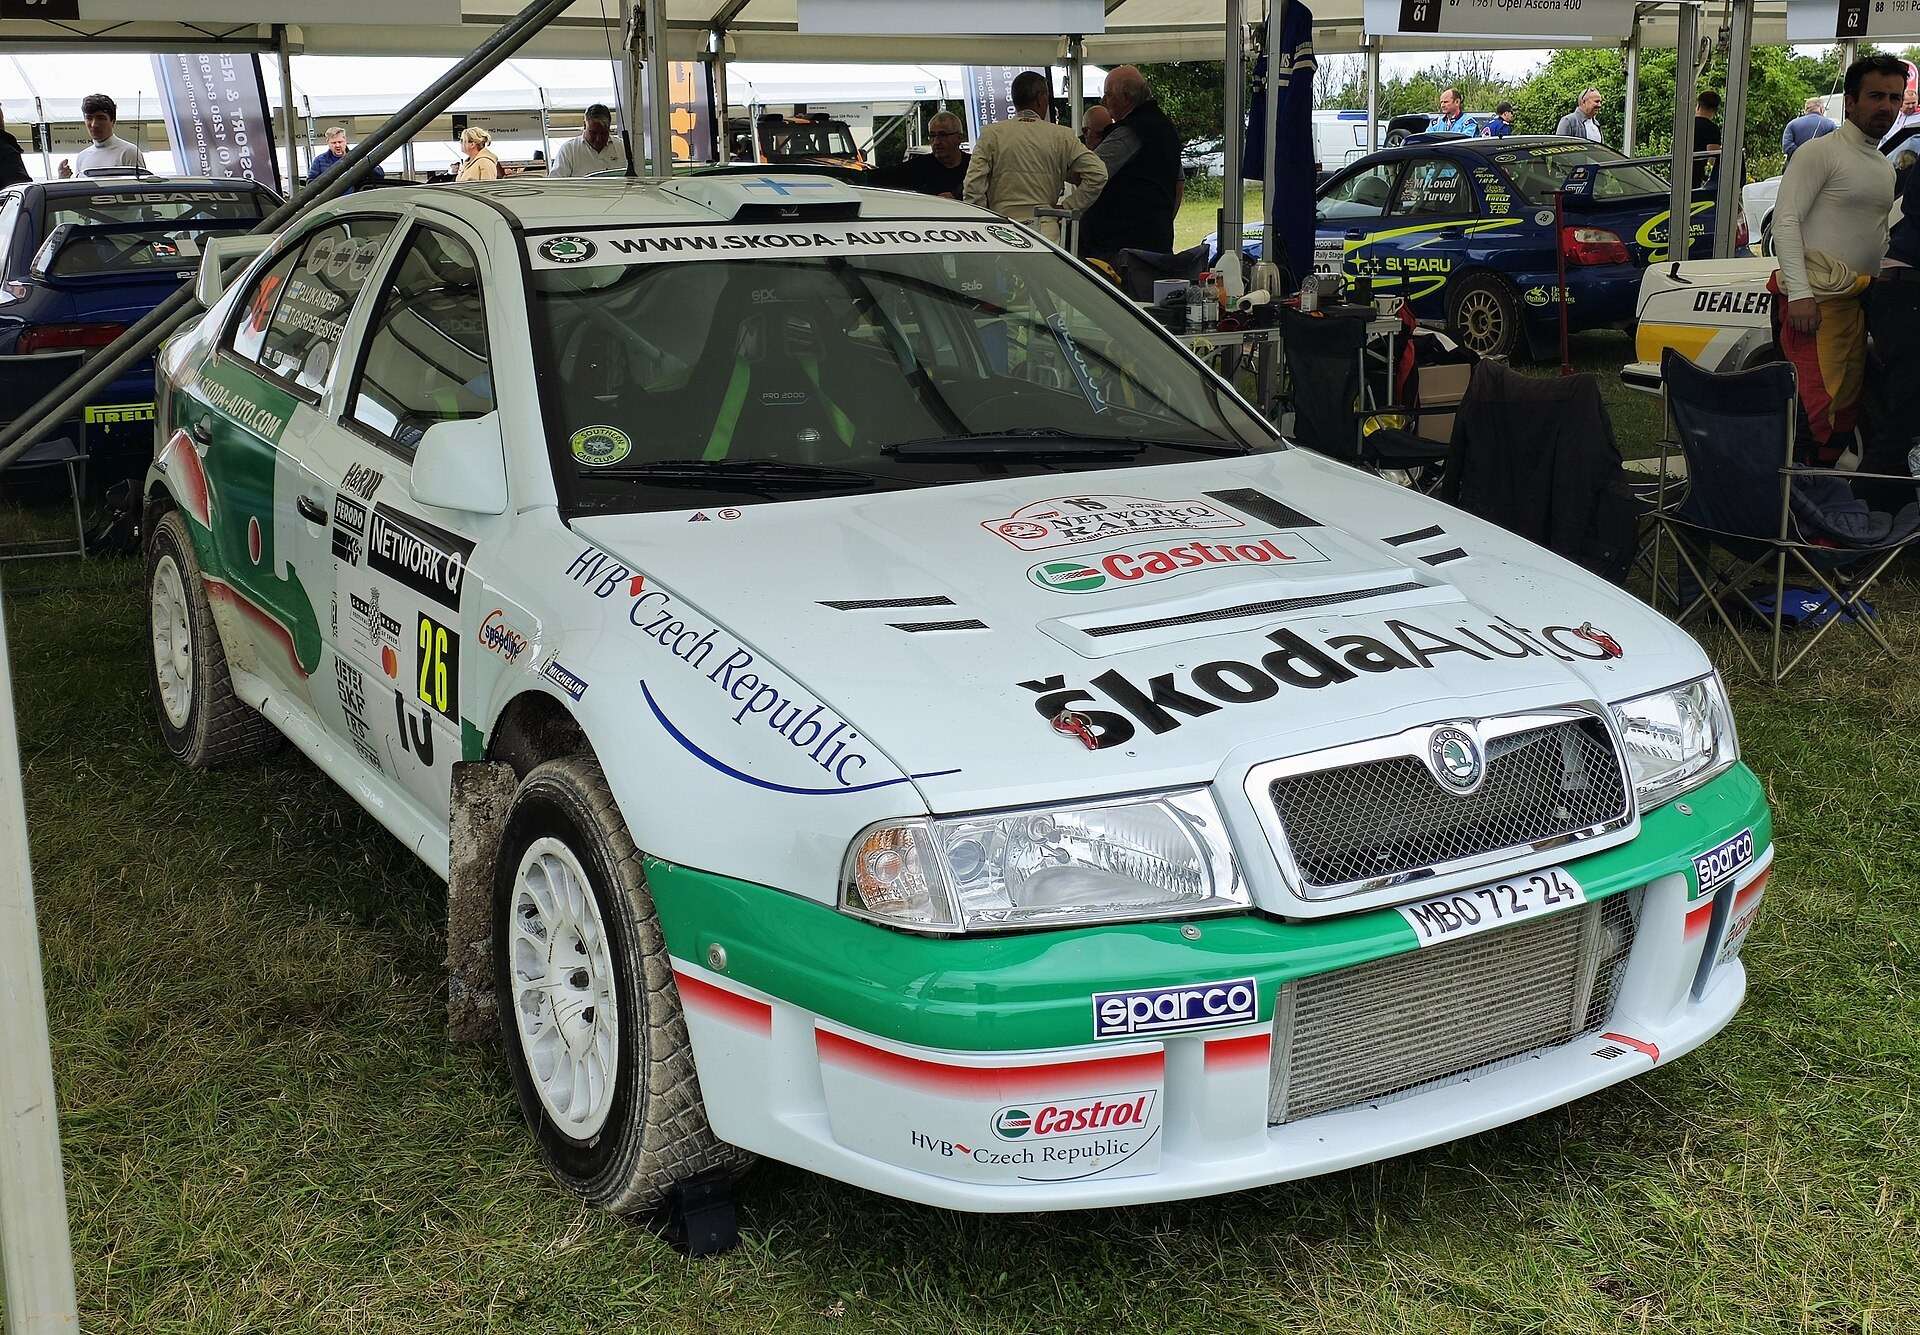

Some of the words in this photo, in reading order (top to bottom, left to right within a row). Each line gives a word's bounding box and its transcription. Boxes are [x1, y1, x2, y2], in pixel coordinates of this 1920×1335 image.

[1413, 4, 1427, 21] 61
[1524, 0, 1561, 10] Ascona
[1562, 0, 1581, 10] 400
[1875, 2, 1885, 12] 88
[1847, 13, 1858, 27] 62
[91, 192, 239, 205] SUBARU
[1423, 191, 1456, 204] Turvey
[609, 230, 987, 254] WWW.SKODA-AUTO.COM
[1693, 291, 1772, 314] DEALER
[580, 429, 625, 445] SOUTHERN
[577, 451, 591, 462] CAR
[594, 455, 615, 463] CLUB
[336, 500, 363, 530] FERODO
[1049, 508, 1188, 530] NETWORK
[1186, 506, 1215, 518] Q
[1059, 516, 1192, 539] RALLY
[371, 515, 439, 585] NETWORK
[446, 551, 463, 595] Q
[1101, 539, 1297, 581] Castrol
[419, 618, 447, 713] 26
[565, 546, 629, 598] HVB
[629, 590, 719, 671] Czech
[706, 647, 866, 786] Republic
[547, 665, 585, 695] MICHELIN
[1699, 835, 1752, 887] sparco
[1477, 874, 1574, 919] 72-24
[1101, 985, 1252, 1034] sparco
[1591, 1045, 1627, 1060] TOW
[1033, 1096, 1146, 1136] Castrol
[910, 1130, 954, 1158] HVB
[973, 1143, 1033, 1165] Czech
[1043, 1139, 1130, 1168] Republic
